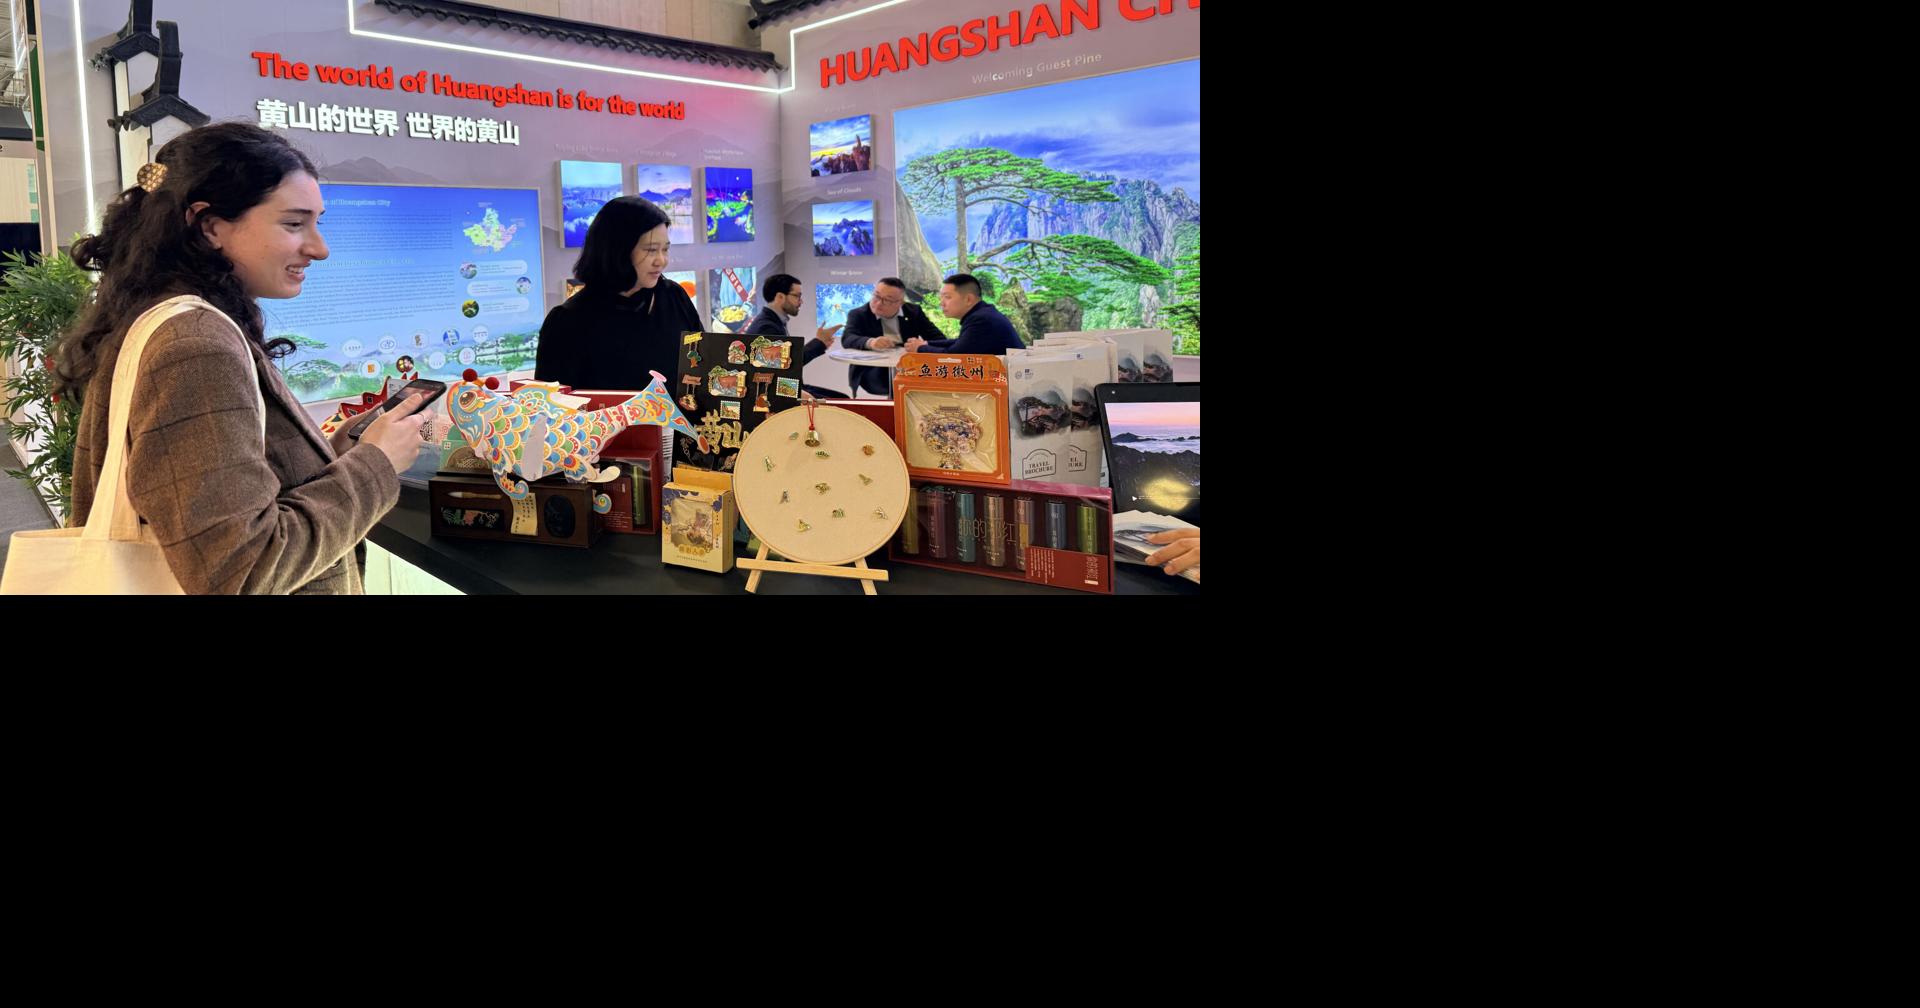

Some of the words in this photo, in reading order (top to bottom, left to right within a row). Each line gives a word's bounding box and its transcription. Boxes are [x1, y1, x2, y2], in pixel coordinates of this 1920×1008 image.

[820, 0, 1099, 88] HUANGSHAN
[252, 51, 310, 81] The
[315, 64, 394, 89] world
[400, 70, 428, 93] of
[433, 73, 553, 107] Huangshan
[557, 88, 574, 109] is
[577, 89, 604, 112] for
[608, 94, 636, 116] the
[639, 101, 685, 120] world
[972, 65, 1033, 84] Welcoming
[1036, 58, 1071, 73] Guest
[1075, 53, 1102, 65] Pine
[256, 99, 400, 137] 黄山的世界
[406, 111, 520, 146] 世界的黄山
[918, 363, 984, 380] 鱼游徽州
[1028, 461, 1050, 469] TRAVEL
